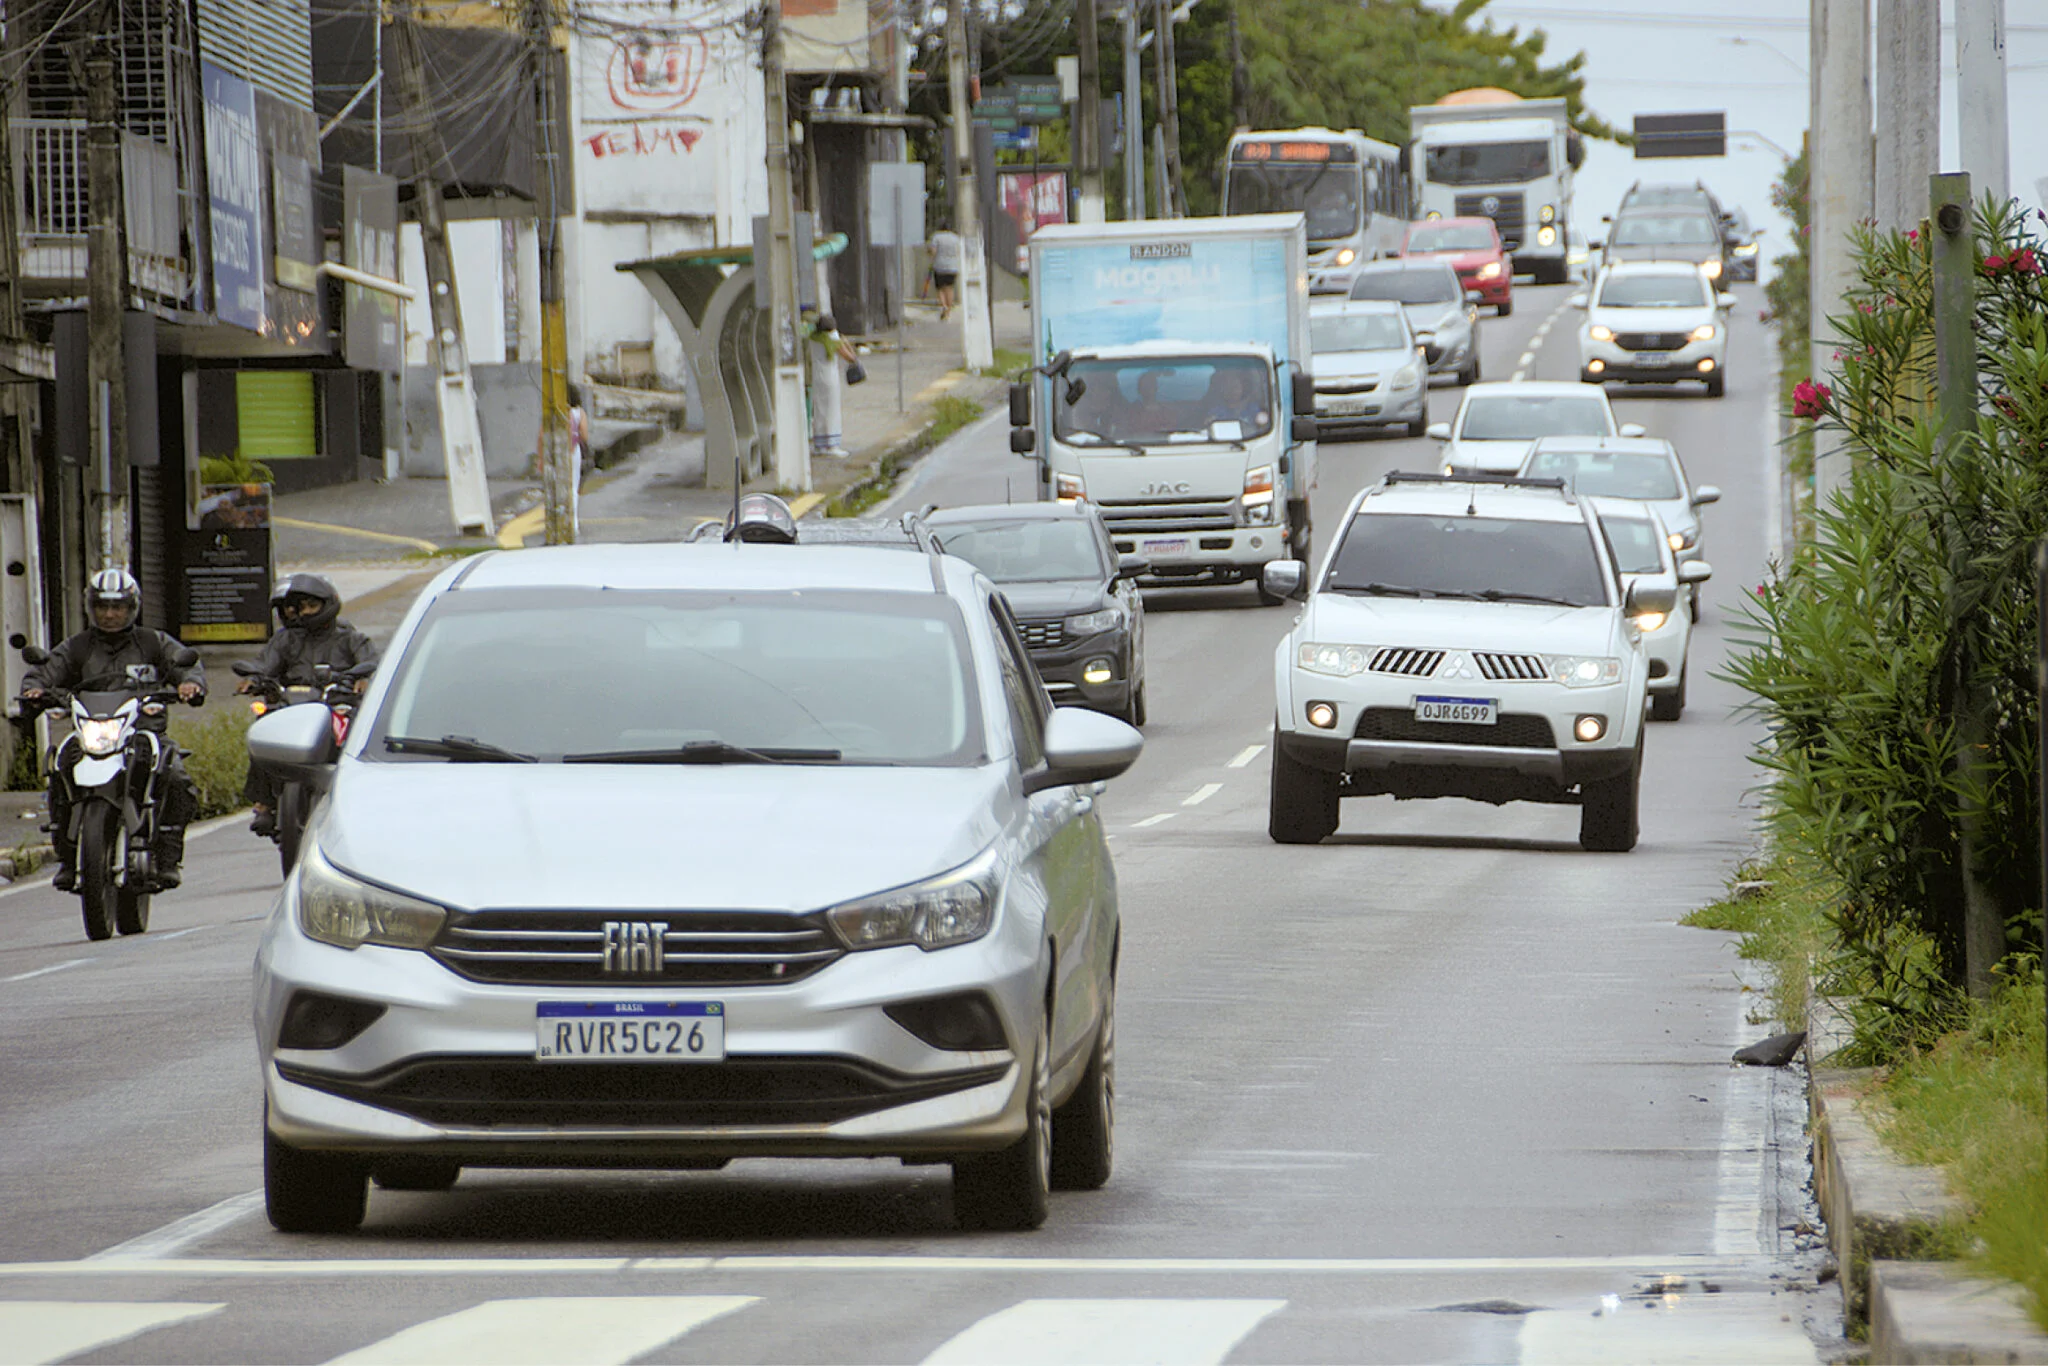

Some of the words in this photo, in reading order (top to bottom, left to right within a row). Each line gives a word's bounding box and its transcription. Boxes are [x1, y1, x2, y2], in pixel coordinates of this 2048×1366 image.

[1131, 242, 1190, 259] RANDON
[1140, 481, 1190, 495] JAC
[1423, 704, 1489, 721] OJR6G99
[603, 921, 668, 971] FIAT
[615, 1003, 645, 1012] BRASIL
[556, 1020, 705, 1054] RVR5C26
